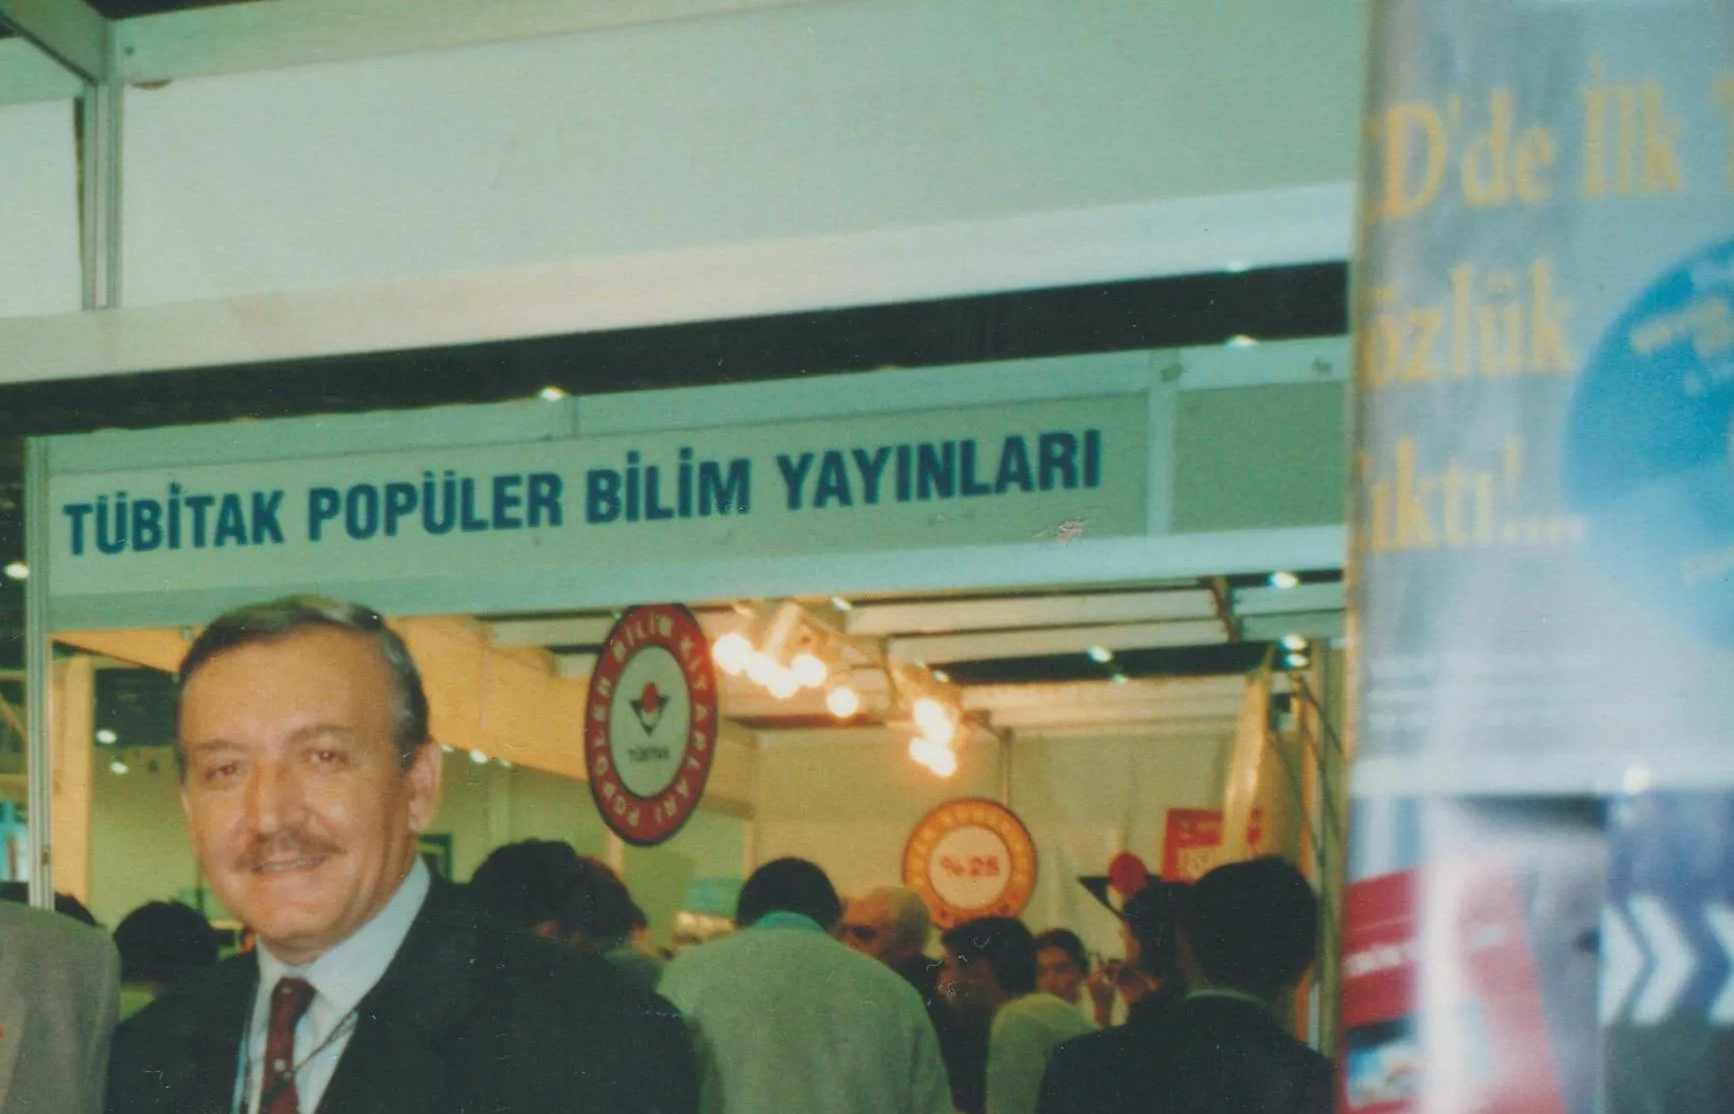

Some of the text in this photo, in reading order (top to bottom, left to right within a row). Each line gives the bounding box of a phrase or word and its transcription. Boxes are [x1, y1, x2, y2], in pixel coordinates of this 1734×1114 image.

[1366, 88, 1557, 226] D'de
[1361, 254, 1574, 390] özlük
[63, 428, 1103, 557] TÜBİTAK POPÜLER BİLİM YAYINLARI
